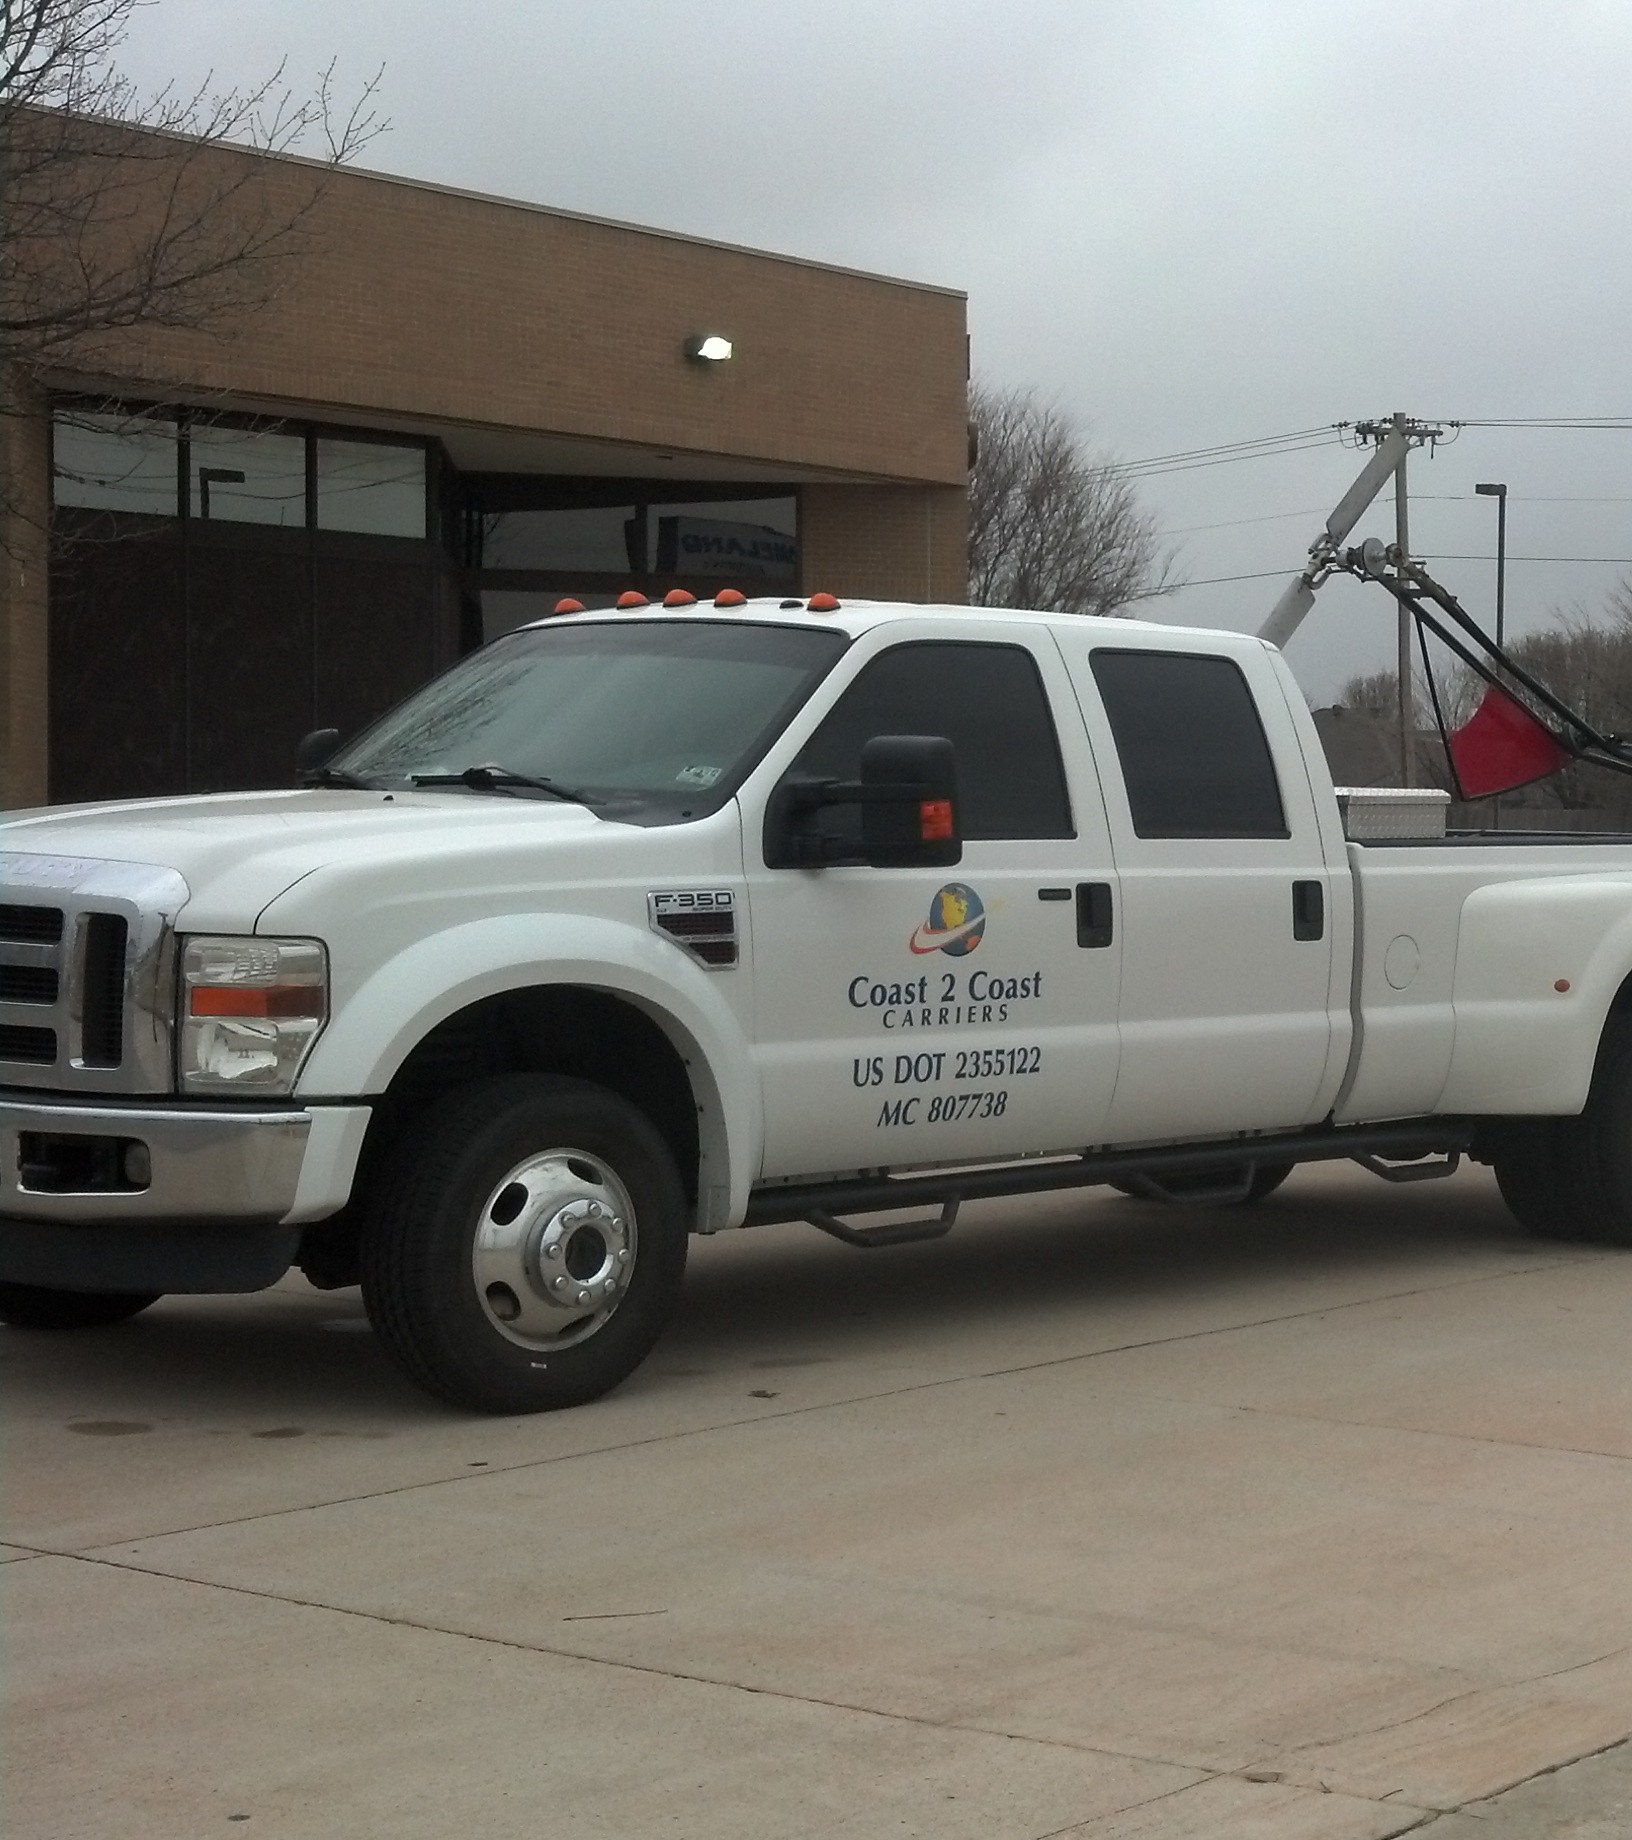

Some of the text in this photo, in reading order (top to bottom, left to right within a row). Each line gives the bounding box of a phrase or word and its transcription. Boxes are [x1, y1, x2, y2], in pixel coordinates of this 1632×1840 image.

[848, 970, 1042, 1008] Coast 2 Coast
[882, 1003, 1008, 1029] CARRIERS
[853, 1046, 1042, 1087] US DOT 2355122
[876, 1090, 1009, 1128] MC 807738
